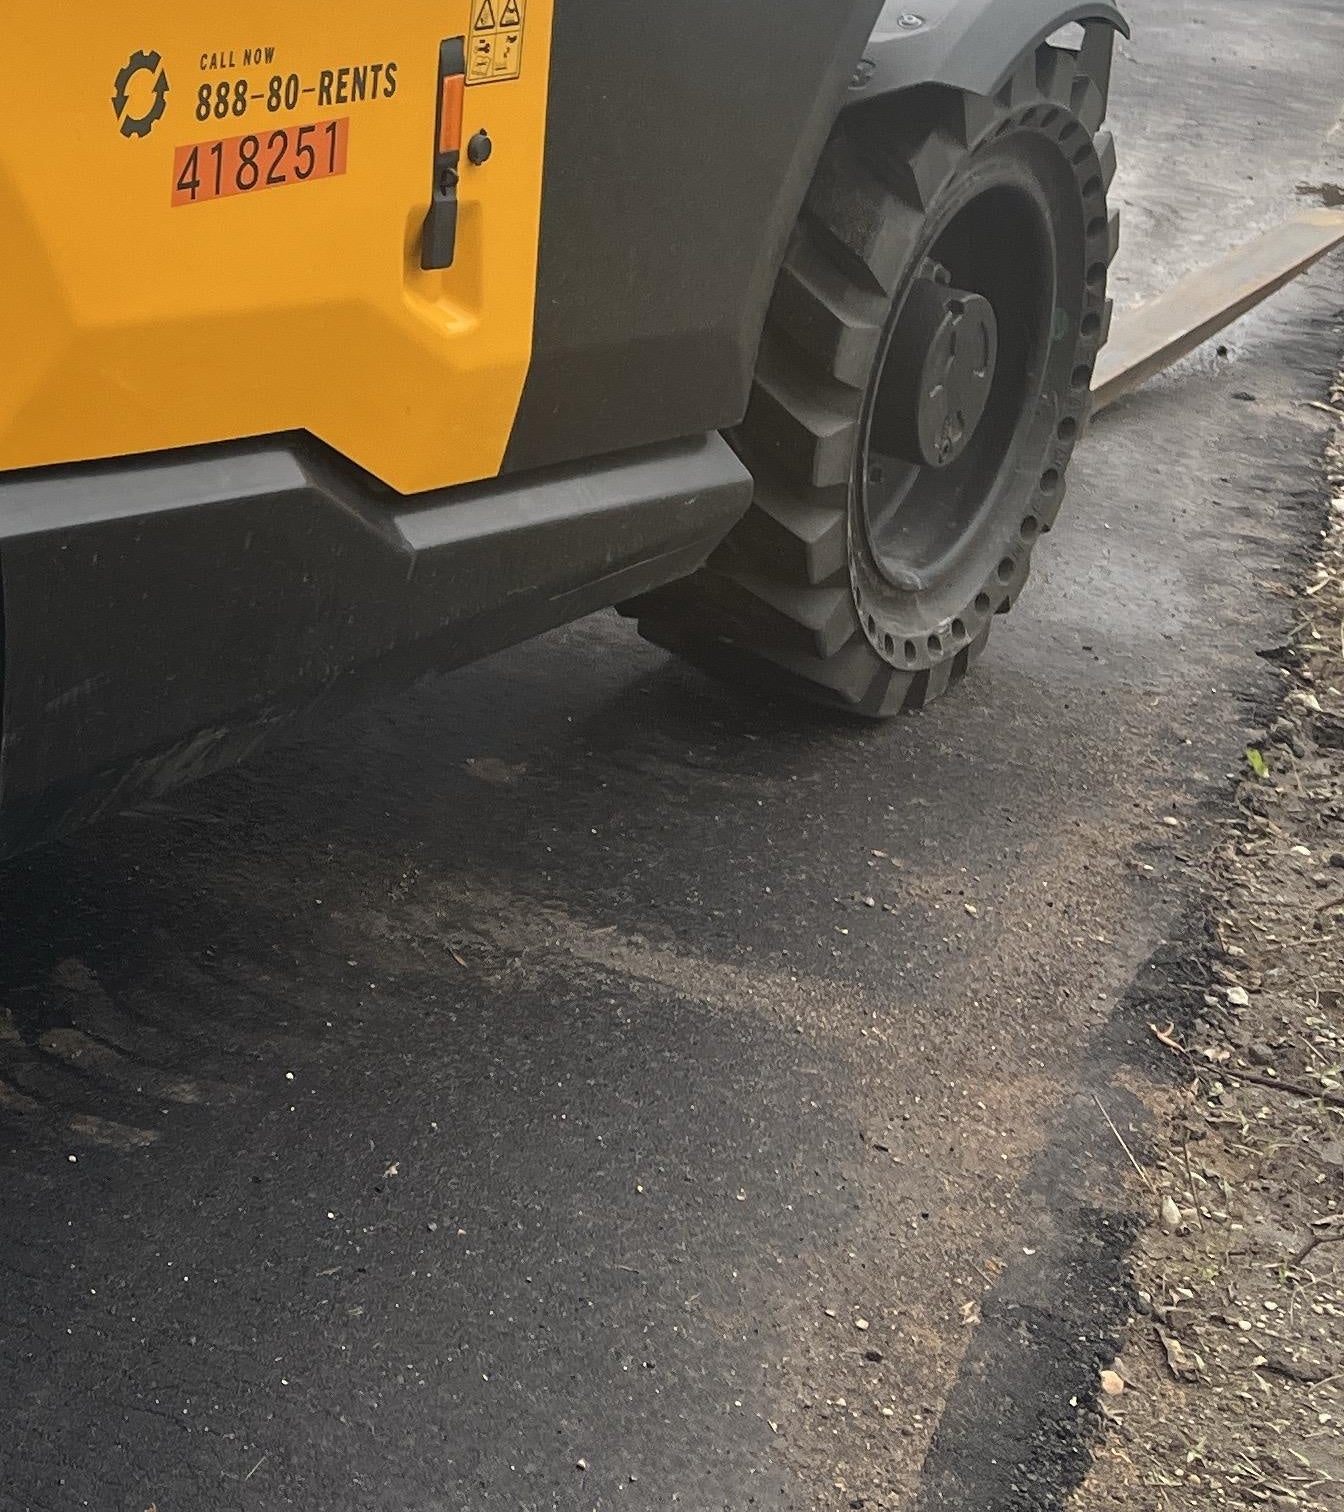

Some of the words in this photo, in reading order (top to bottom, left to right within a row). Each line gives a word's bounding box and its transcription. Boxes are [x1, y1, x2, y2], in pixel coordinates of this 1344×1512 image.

[200, 50, 236, 70] CALL
[243, 46, 275, 66] NOW
[196, 62, 398, 121] 888-80-RENTS
[177, 121, 337, 200] 418251
